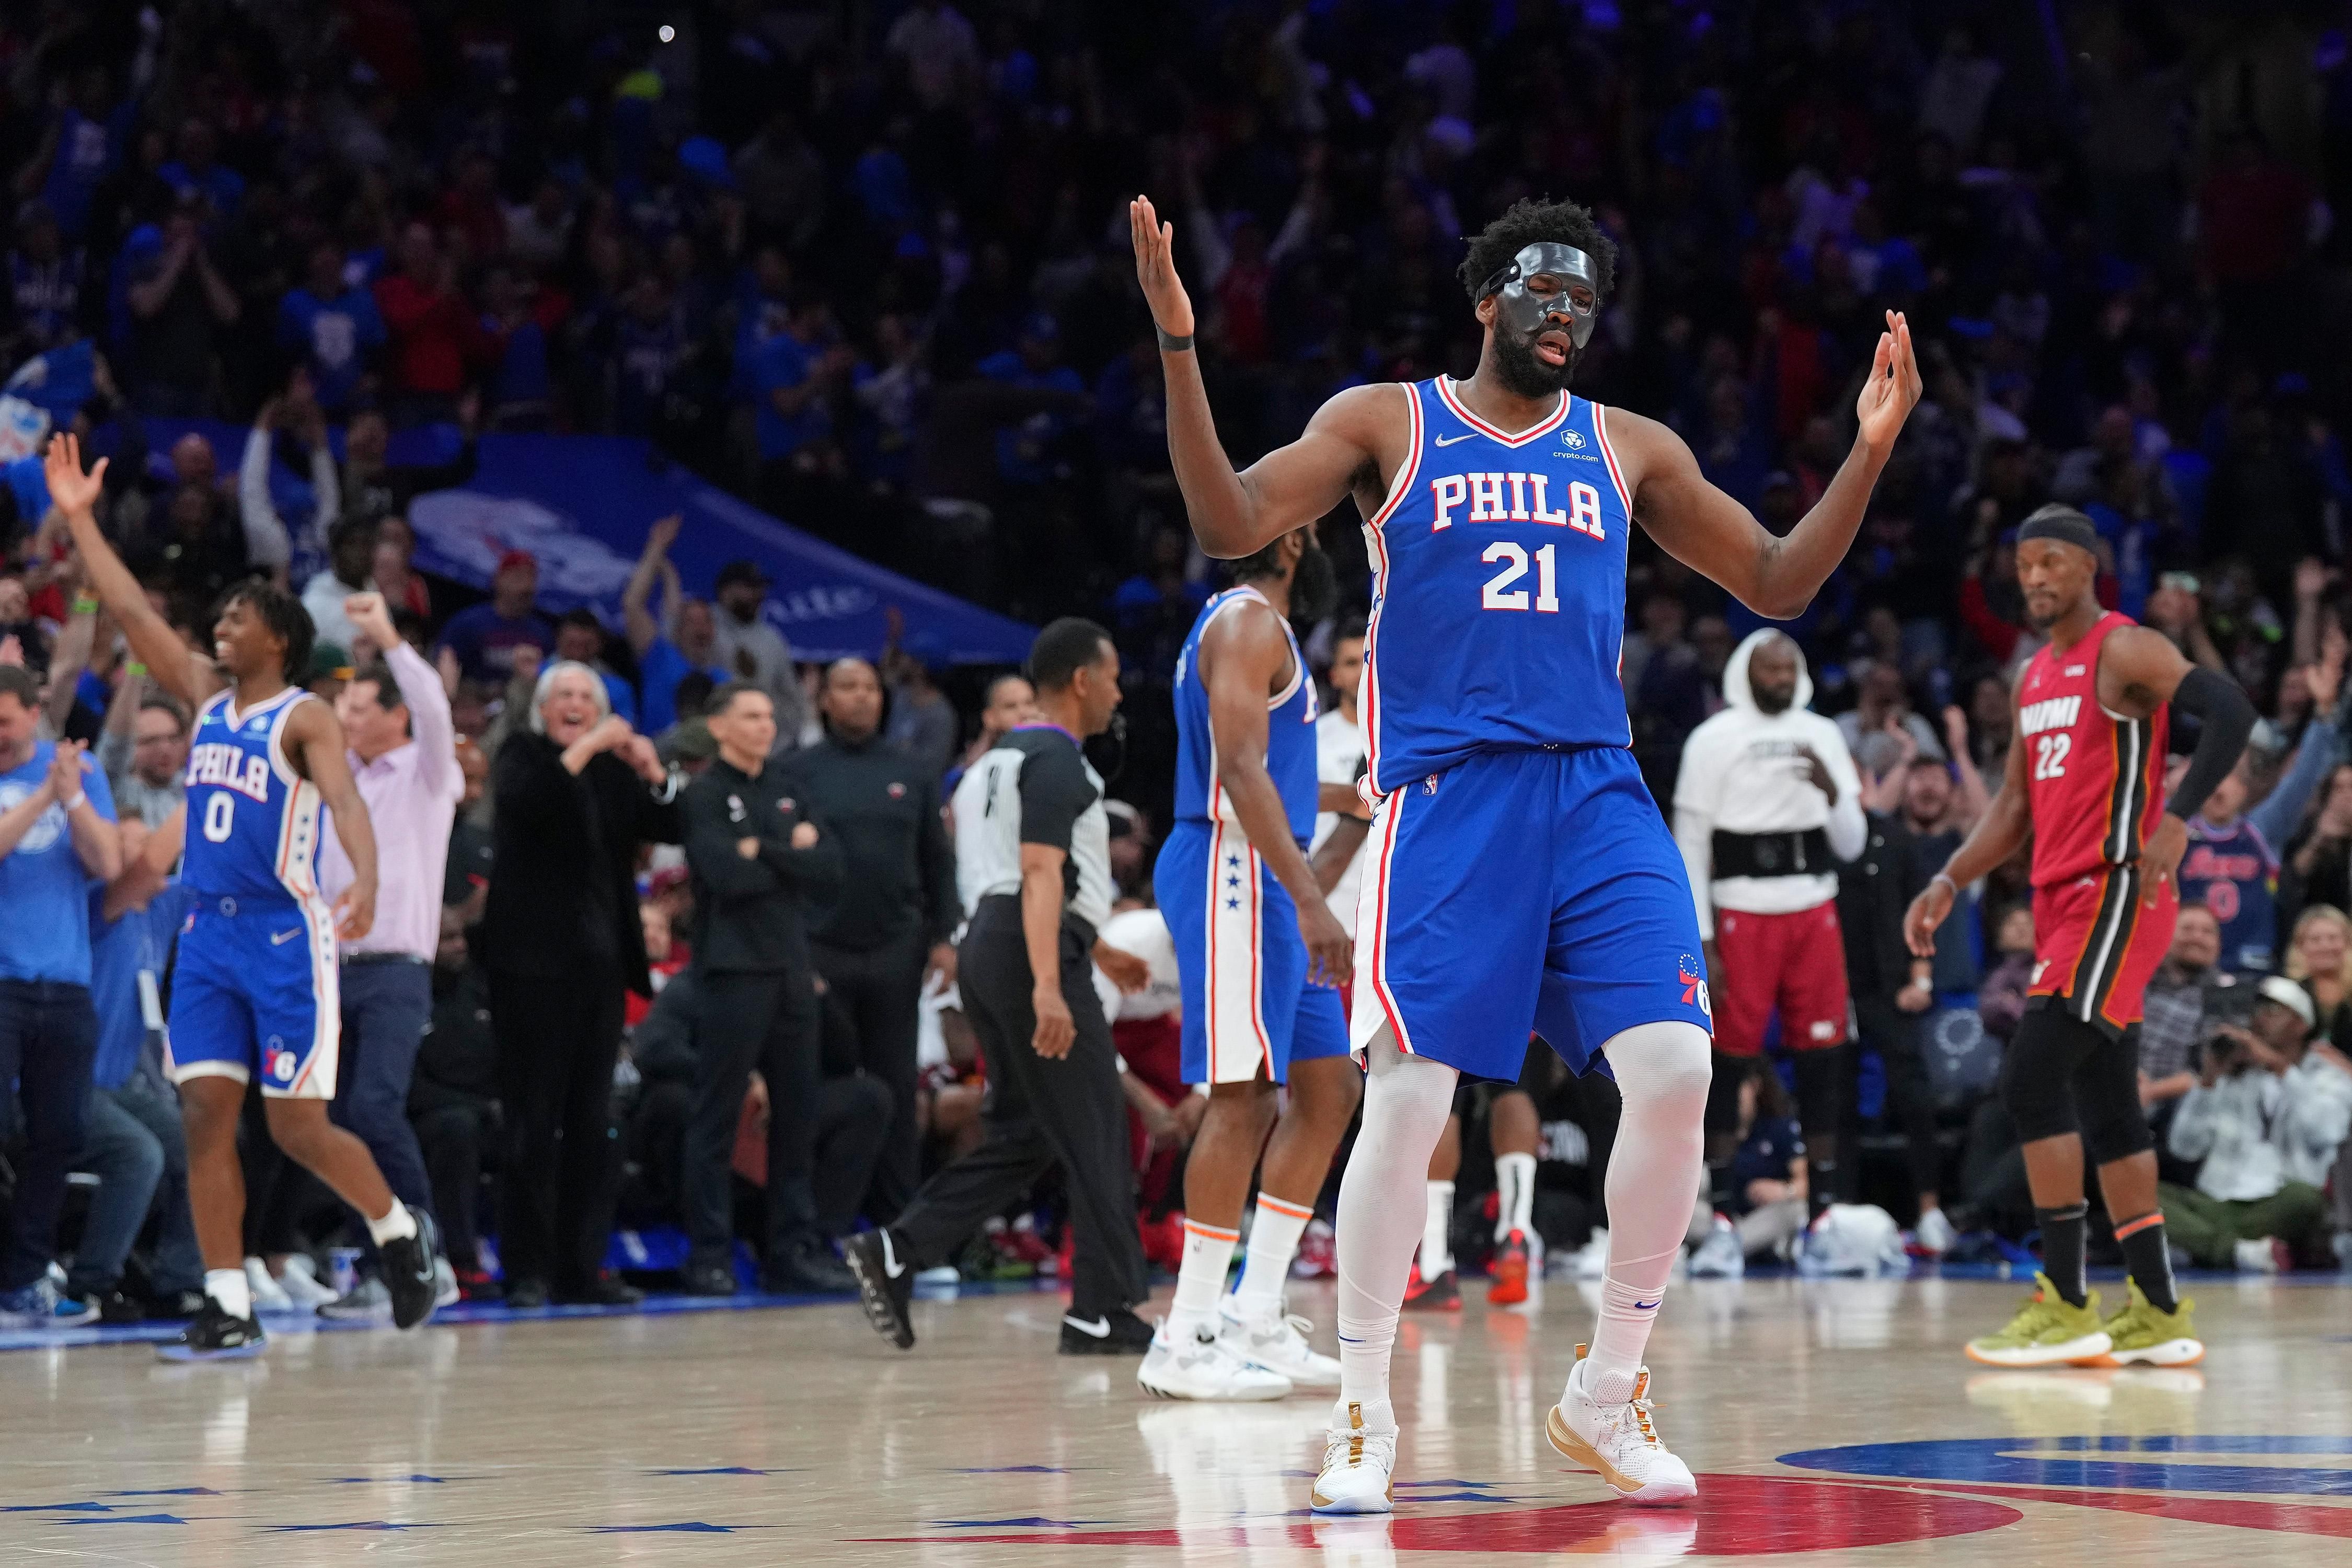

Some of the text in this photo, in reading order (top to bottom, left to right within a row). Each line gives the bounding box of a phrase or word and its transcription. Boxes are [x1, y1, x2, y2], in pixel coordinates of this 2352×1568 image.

[1553, 452, 1599, 462] crypto.com
[1431, 472, 1606, 541] PHILA
[1481, 541, 1559, 613] 21
[185, 743, 270, 803] PHILA
[2034, 733, 2072, 781] 22
[203, 790, 235, 844] 0
[1678, 969, 1710, 1016] 76
